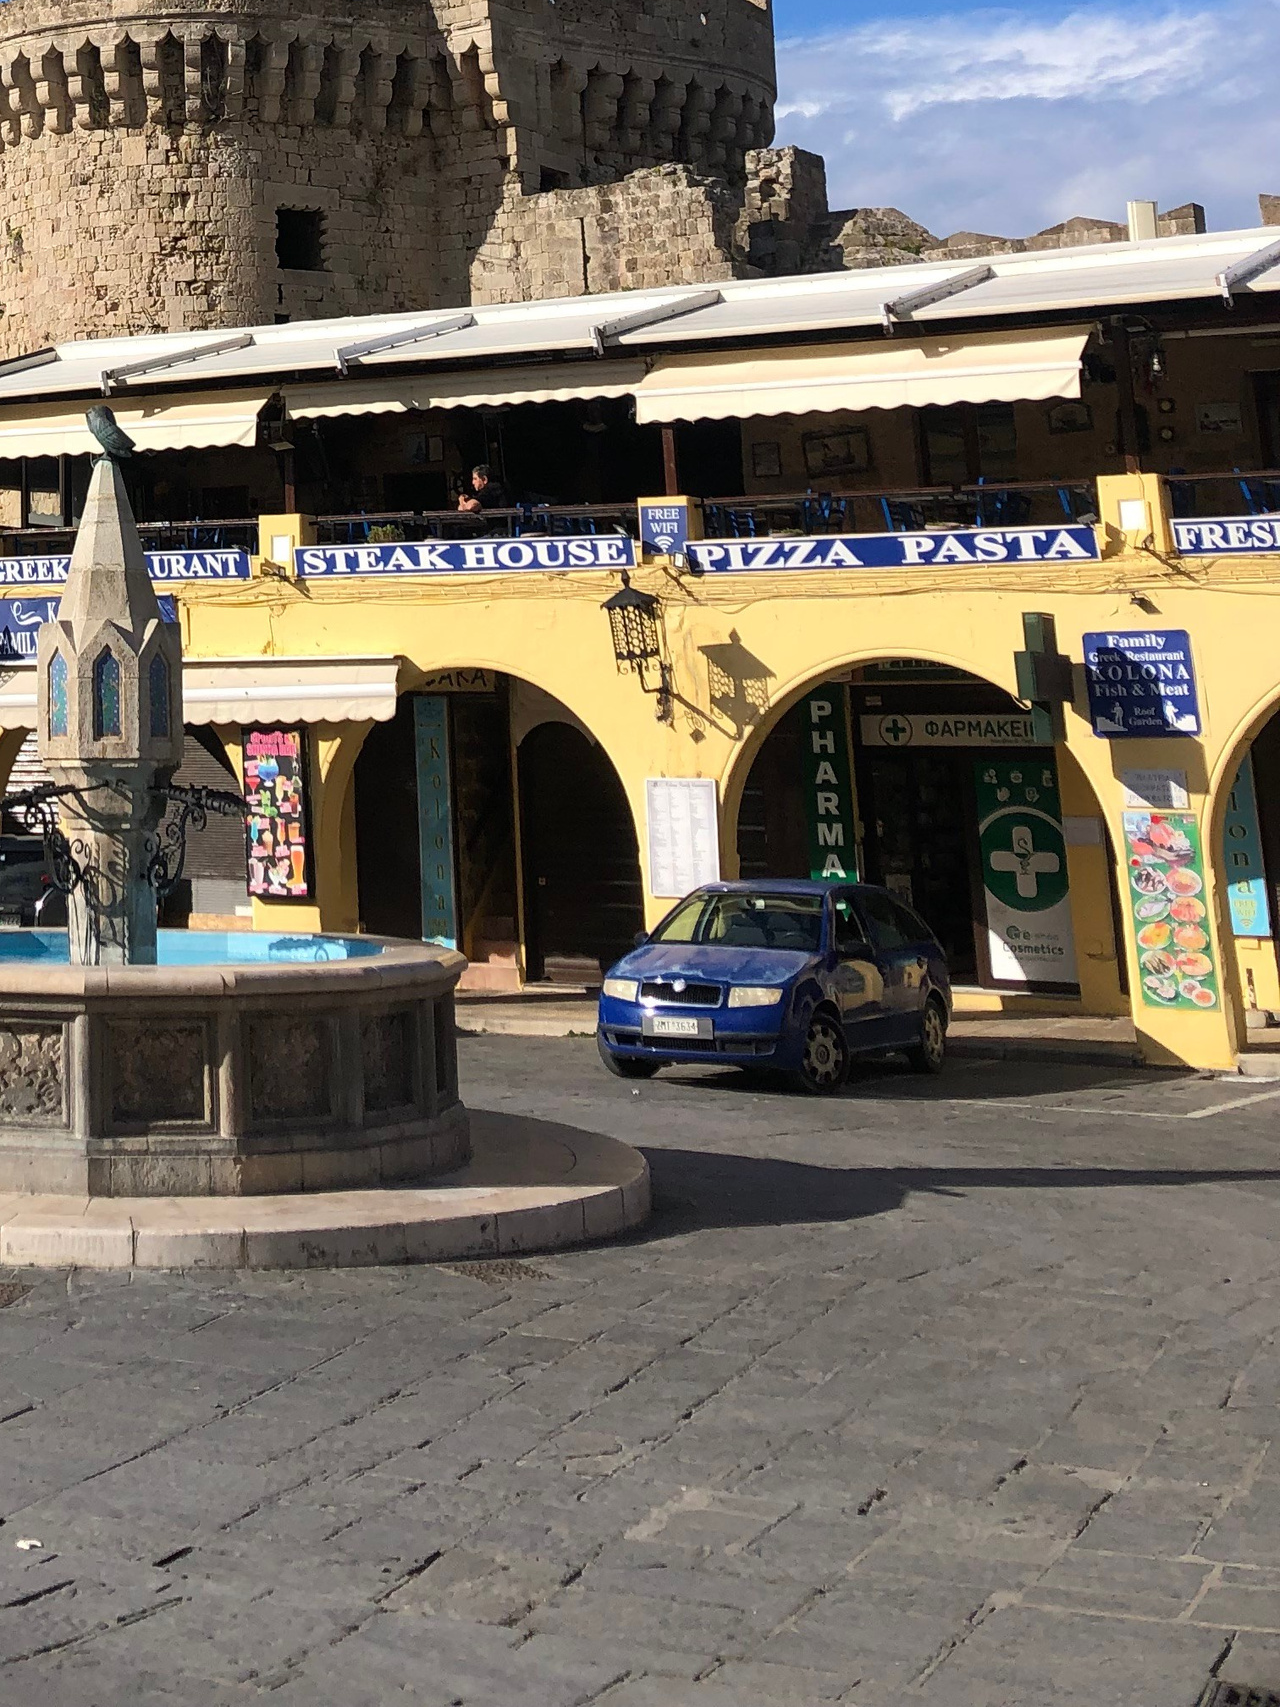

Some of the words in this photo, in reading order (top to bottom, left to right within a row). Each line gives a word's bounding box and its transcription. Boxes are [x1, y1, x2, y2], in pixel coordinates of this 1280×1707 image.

[647, 508, 680, 521] FREE
[650, 521, 679, 534] WIFI
[302, 545, 455, 575] STEAK
[461, 538, 628, 569] HOUSE
[691, 540, 865, 572] PIZZA
[897, 530, 1092, 565] PASTA
[148, 554, 240, 578] URANT
[1107, 634, 1166, 650] Family
[1089, 651, 1120, 663] Greek
[1125, 650, 1185, 662] Restaurant
[1090, 663, 1191, 681] KOLONA
[1094, 683, 1128, 697] Fish
[1131, 682, 1145, 696] &
[1150, 682, 1190, 697] Meat
[1133, 706, 1156, 716] Roof
[924, 719, 1034, 739] ΦΑΡΜΑΚΕΙ
[1128, 716, 1163, 727] Garden
[809, 700, 848, 879] PHARMA
[1003, 941, 1065, 956] Cosmetics
